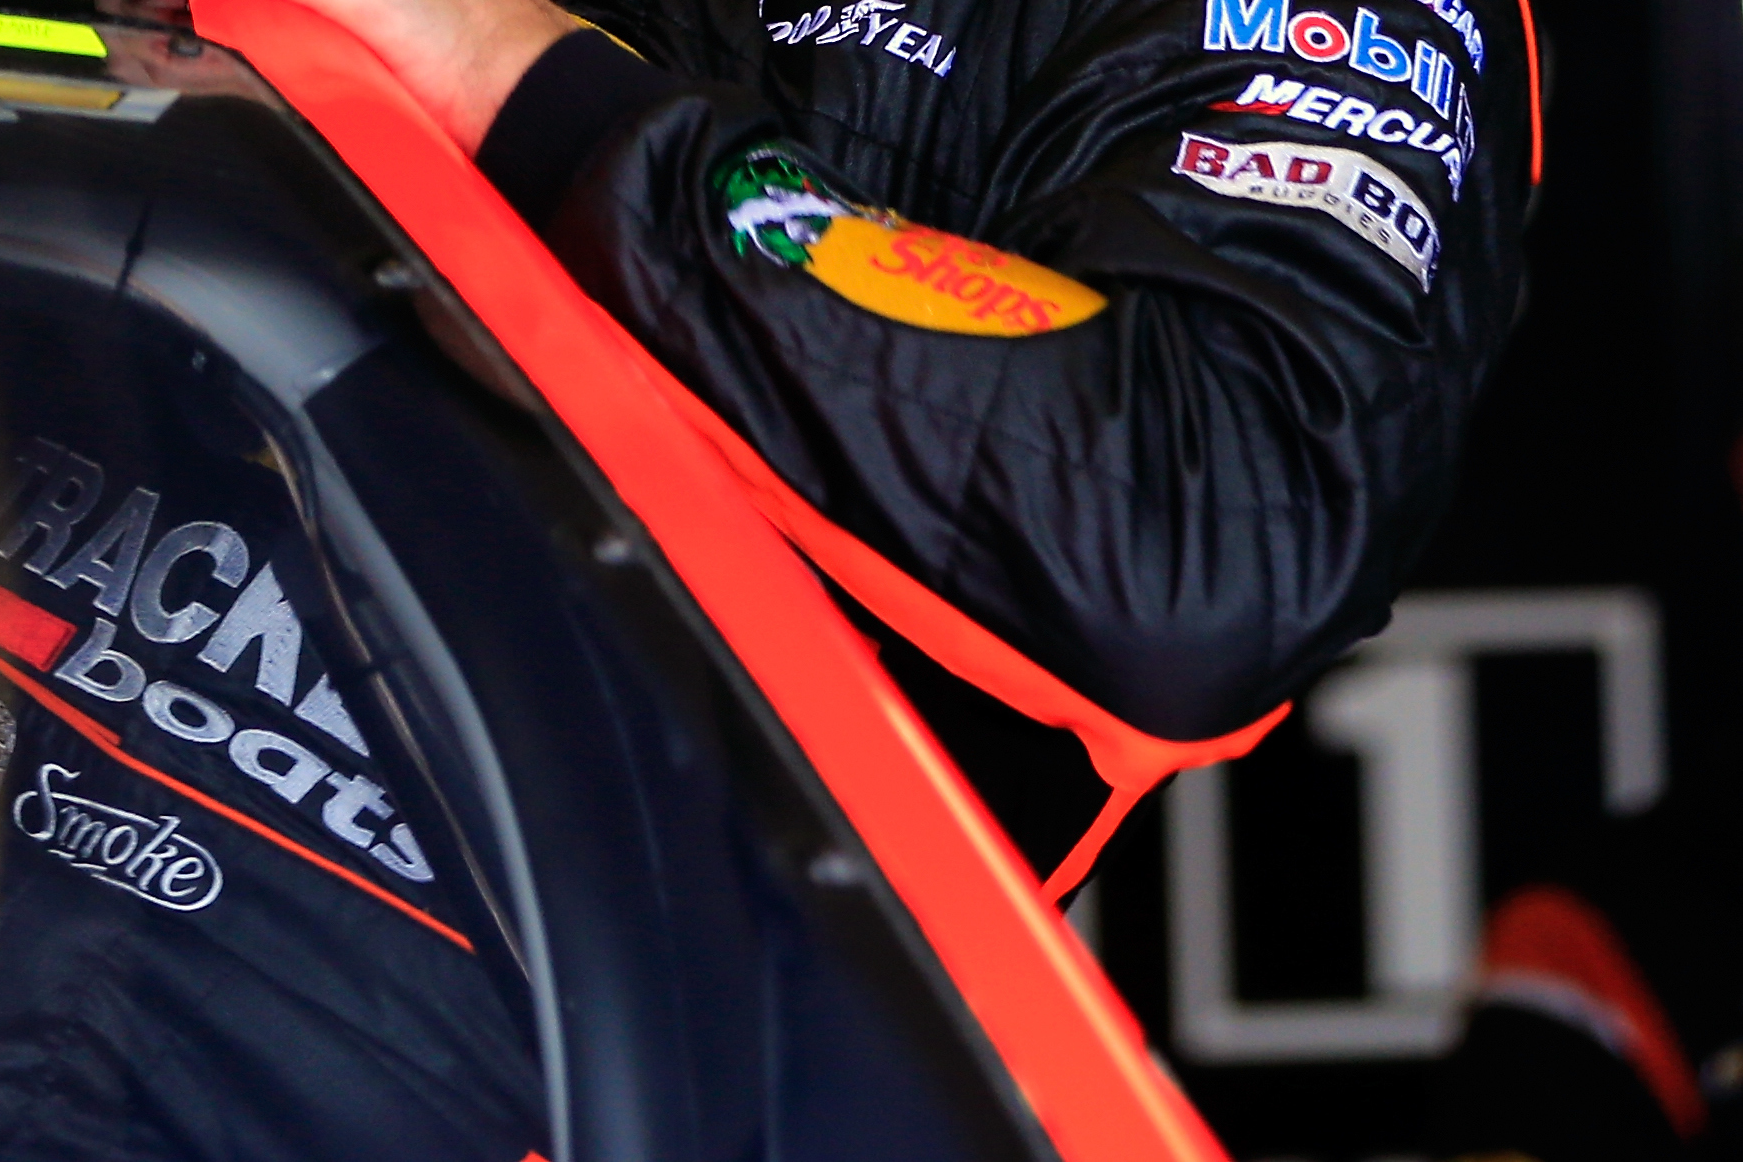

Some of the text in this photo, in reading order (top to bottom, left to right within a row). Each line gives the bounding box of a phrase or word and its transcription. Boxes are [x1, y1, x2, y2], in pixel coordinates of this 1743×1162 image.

[1180, 138, 1440, 270] BAD BO
[870, 228, 1062, 332] Shops
[13, 763, 224, 912] Smoke
